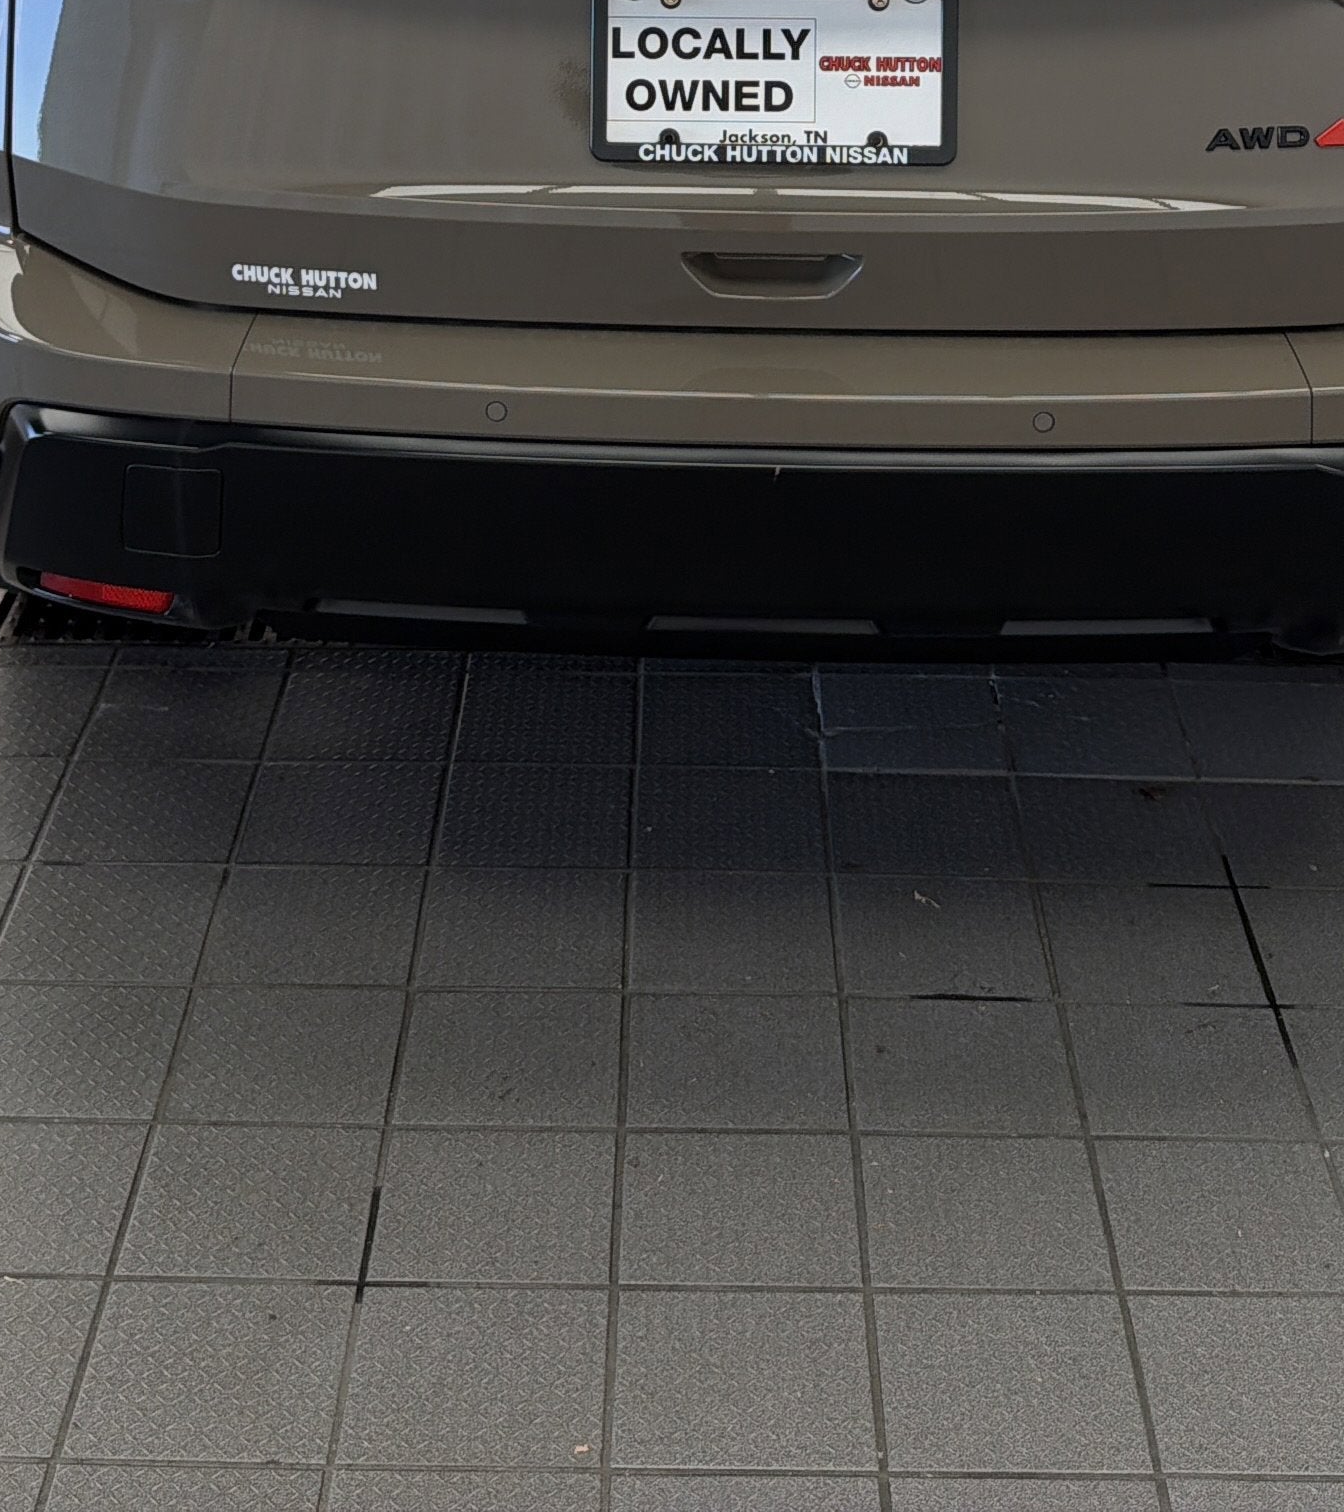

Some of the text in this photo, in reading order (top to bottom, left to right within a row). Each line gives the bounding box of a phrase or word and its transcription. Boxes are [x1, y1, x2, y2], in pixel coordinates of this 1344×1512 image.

[611, 26, 811, 61] LOCALLY
[818, 55, 943, 73] CHUCK HUTTON
[863, 75, 920, 87] NISSAN
[625, 79, 794, 112] OWNED
[719, 129, 828, 145] Jackson, TN
[1205, 126, 1311, 152] AWD
[638, 144, 908, 164] CHUCK HUTTON NISSAN
[231, 263, 378, 291] CHUCK HUTTON
[267, 285, 343, 299] NISSAN
